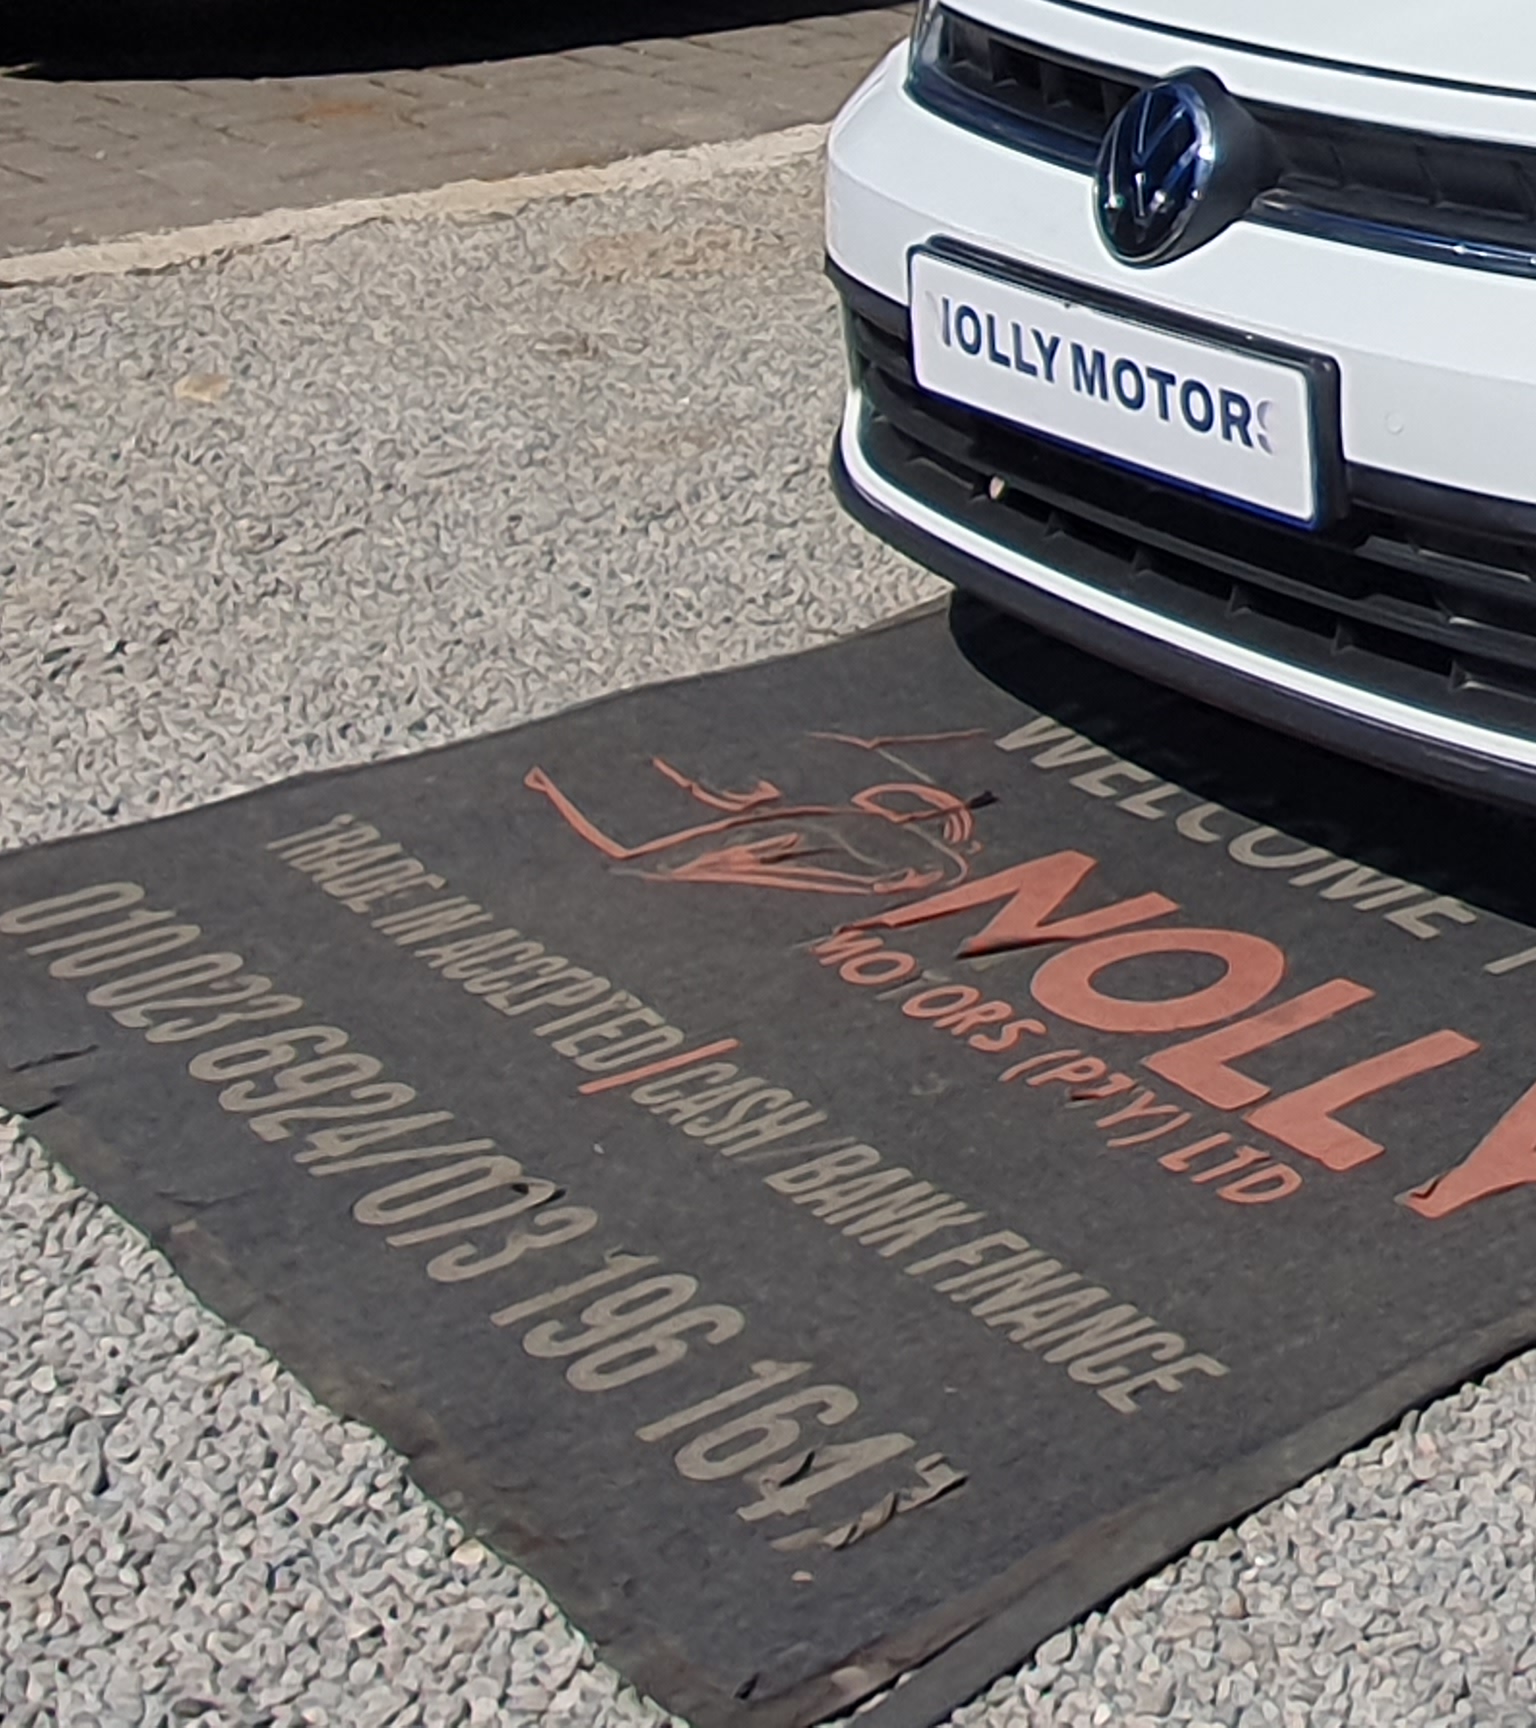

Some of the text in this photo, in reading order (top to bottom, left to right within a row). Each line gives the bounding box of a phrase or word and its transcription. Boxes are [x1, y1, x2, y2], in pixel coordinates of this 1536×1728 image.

[0, 881, 202, 979] 010
[87, 951, 303, 1044] 023
[266, 813, 448, 914] TRADE
[371, 896, 494, 947] IN
[904, 1229, 1231, 1414] FINANCE
[1157, 1131, 1303, 1205] LTD
[489, 1246, 746, 1393] 196
